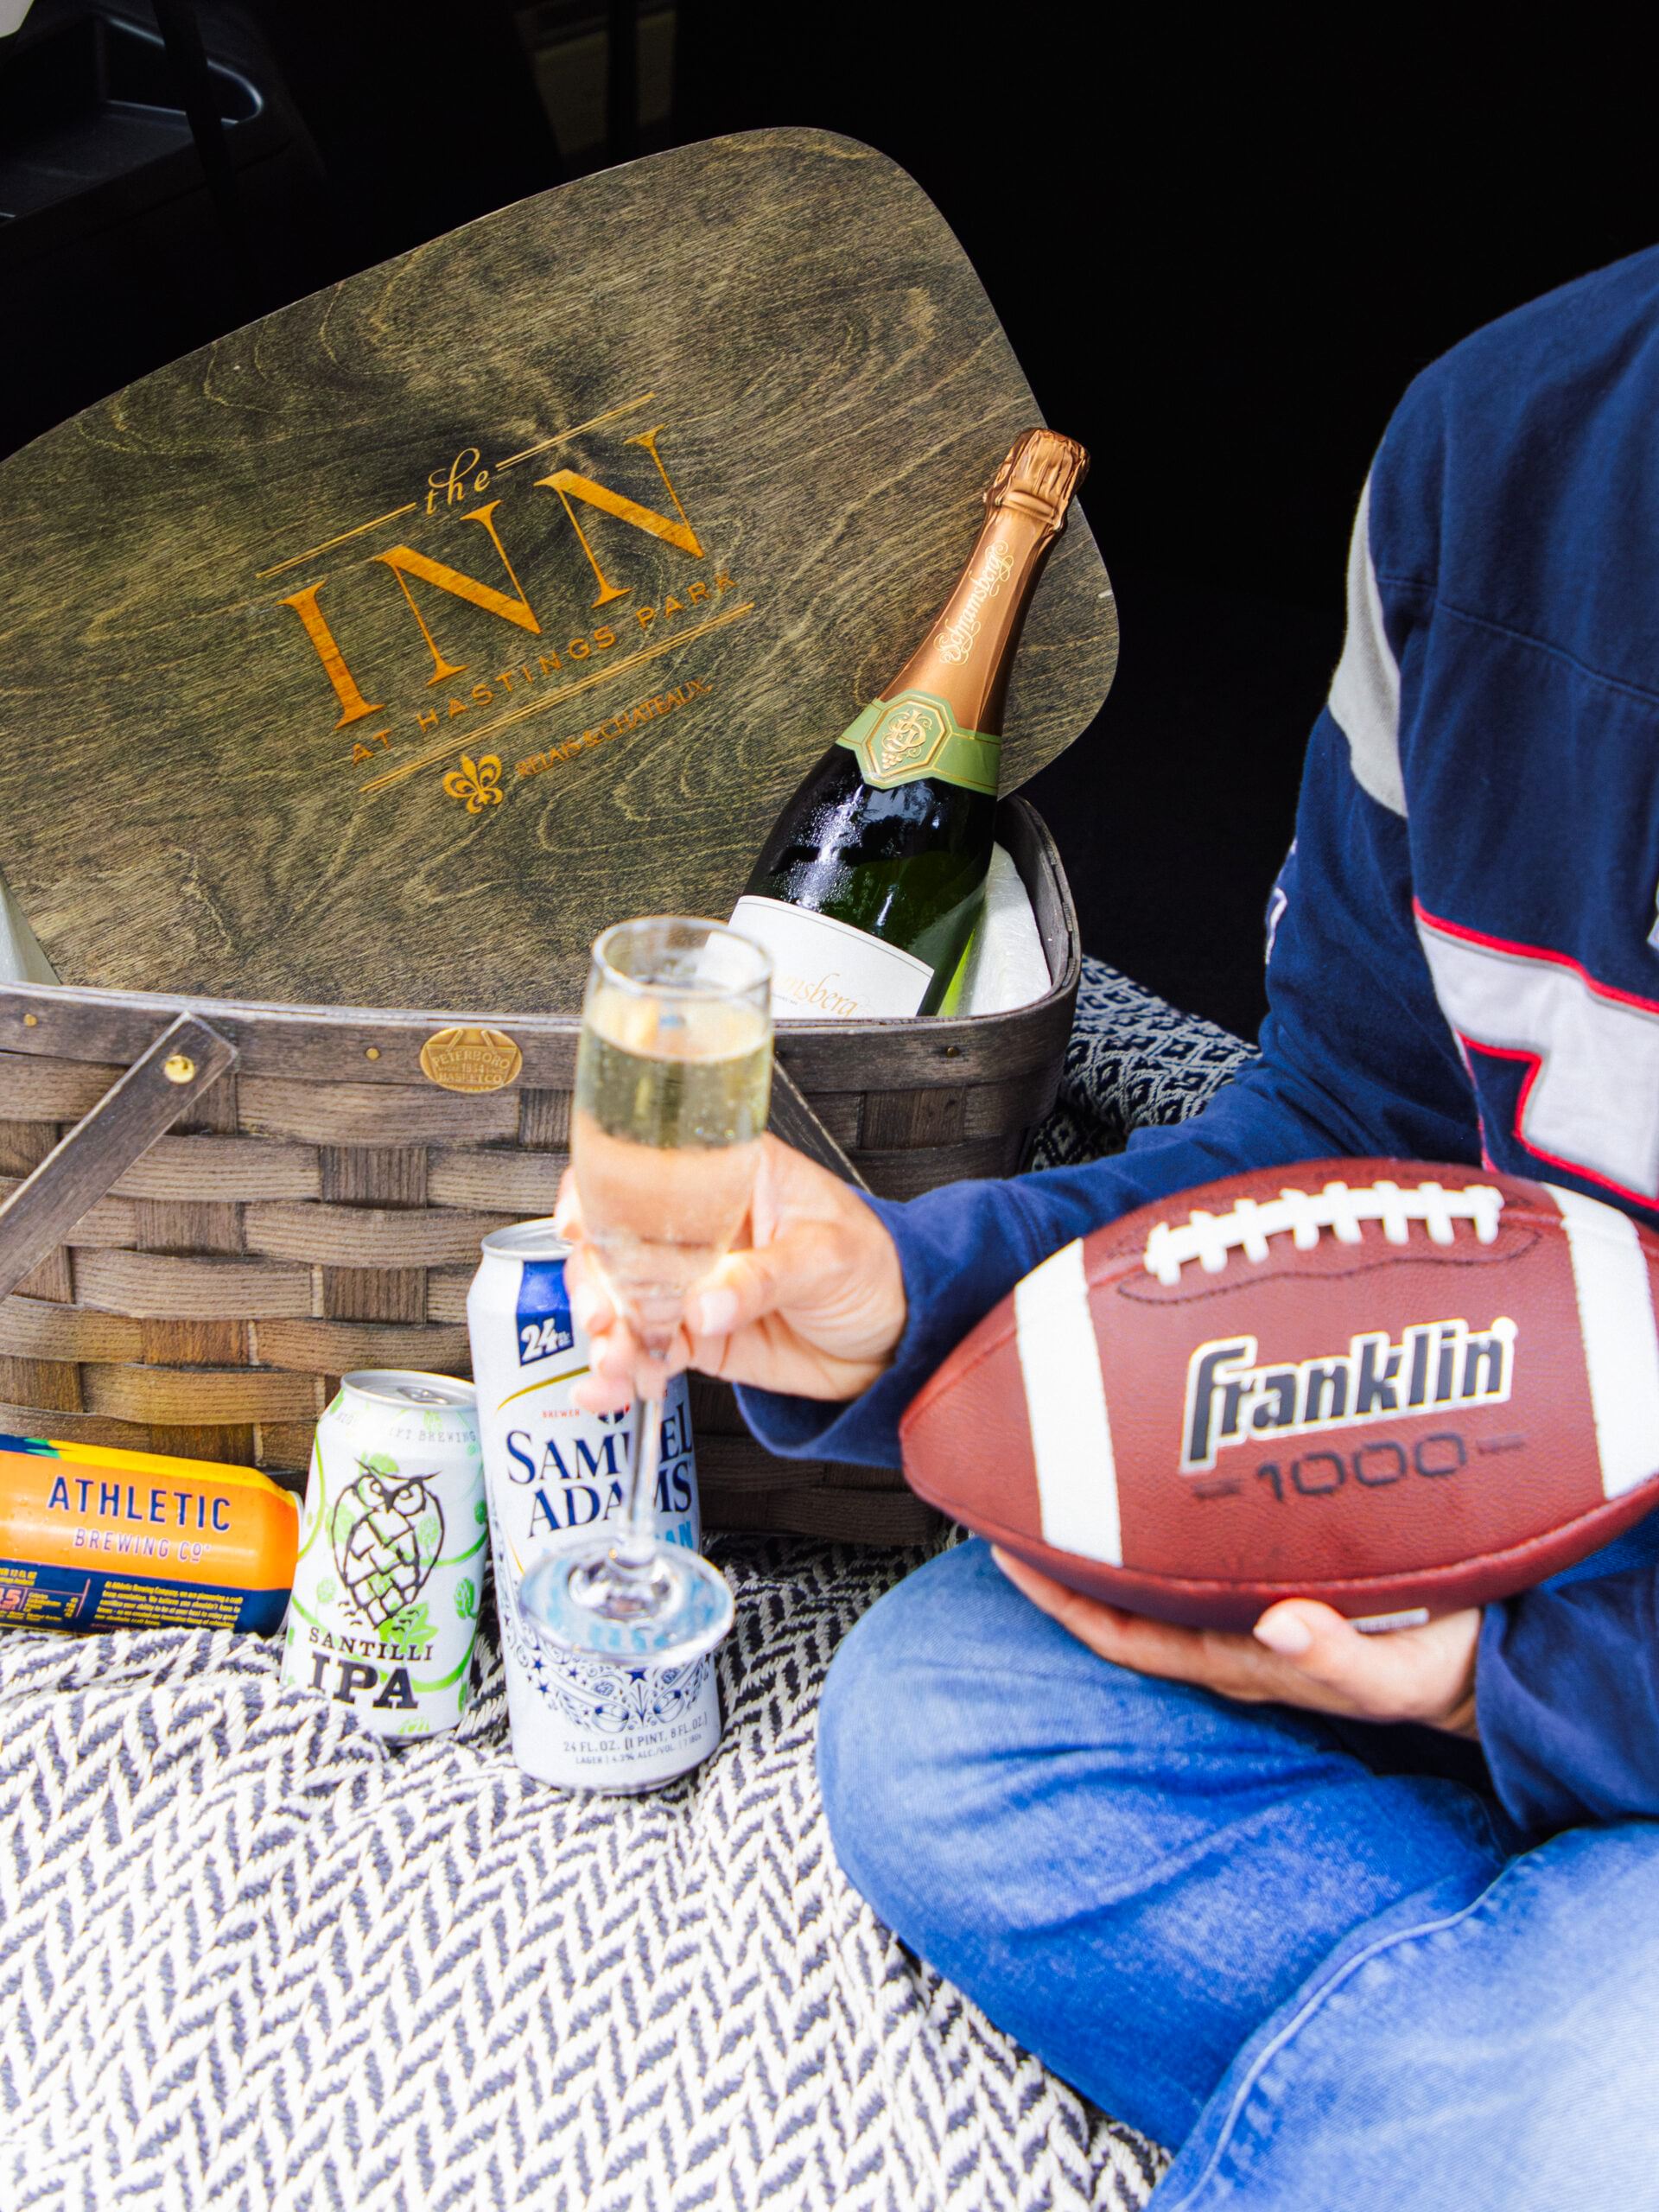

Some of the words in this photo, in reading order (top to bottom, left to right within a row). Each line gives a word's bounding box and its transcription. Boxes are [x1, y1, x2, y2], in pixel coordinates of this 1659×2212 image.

[423, 447, 491, 516] the
[276, 423, 704, 730] INN
[933, 539, 1014, 666] Schramsberg
[351, 728, 392, 766] AT
[417, 625, 618, 734] HASTINGS
[637, 570, 740, 632] PARK
[432, 1049, 510, 1070] PETERBORO
[520, 1317, 558, 1363] 24
[1256, 1431, 1467, 1502] 1000
[48, 1475, 231, 1532] ATHLETIC
[73, 1528, 169, 1558] BREWING
[308, 1627, 434, 1661] SANTILLI
[308, 1651, 419, 1710] IPA
